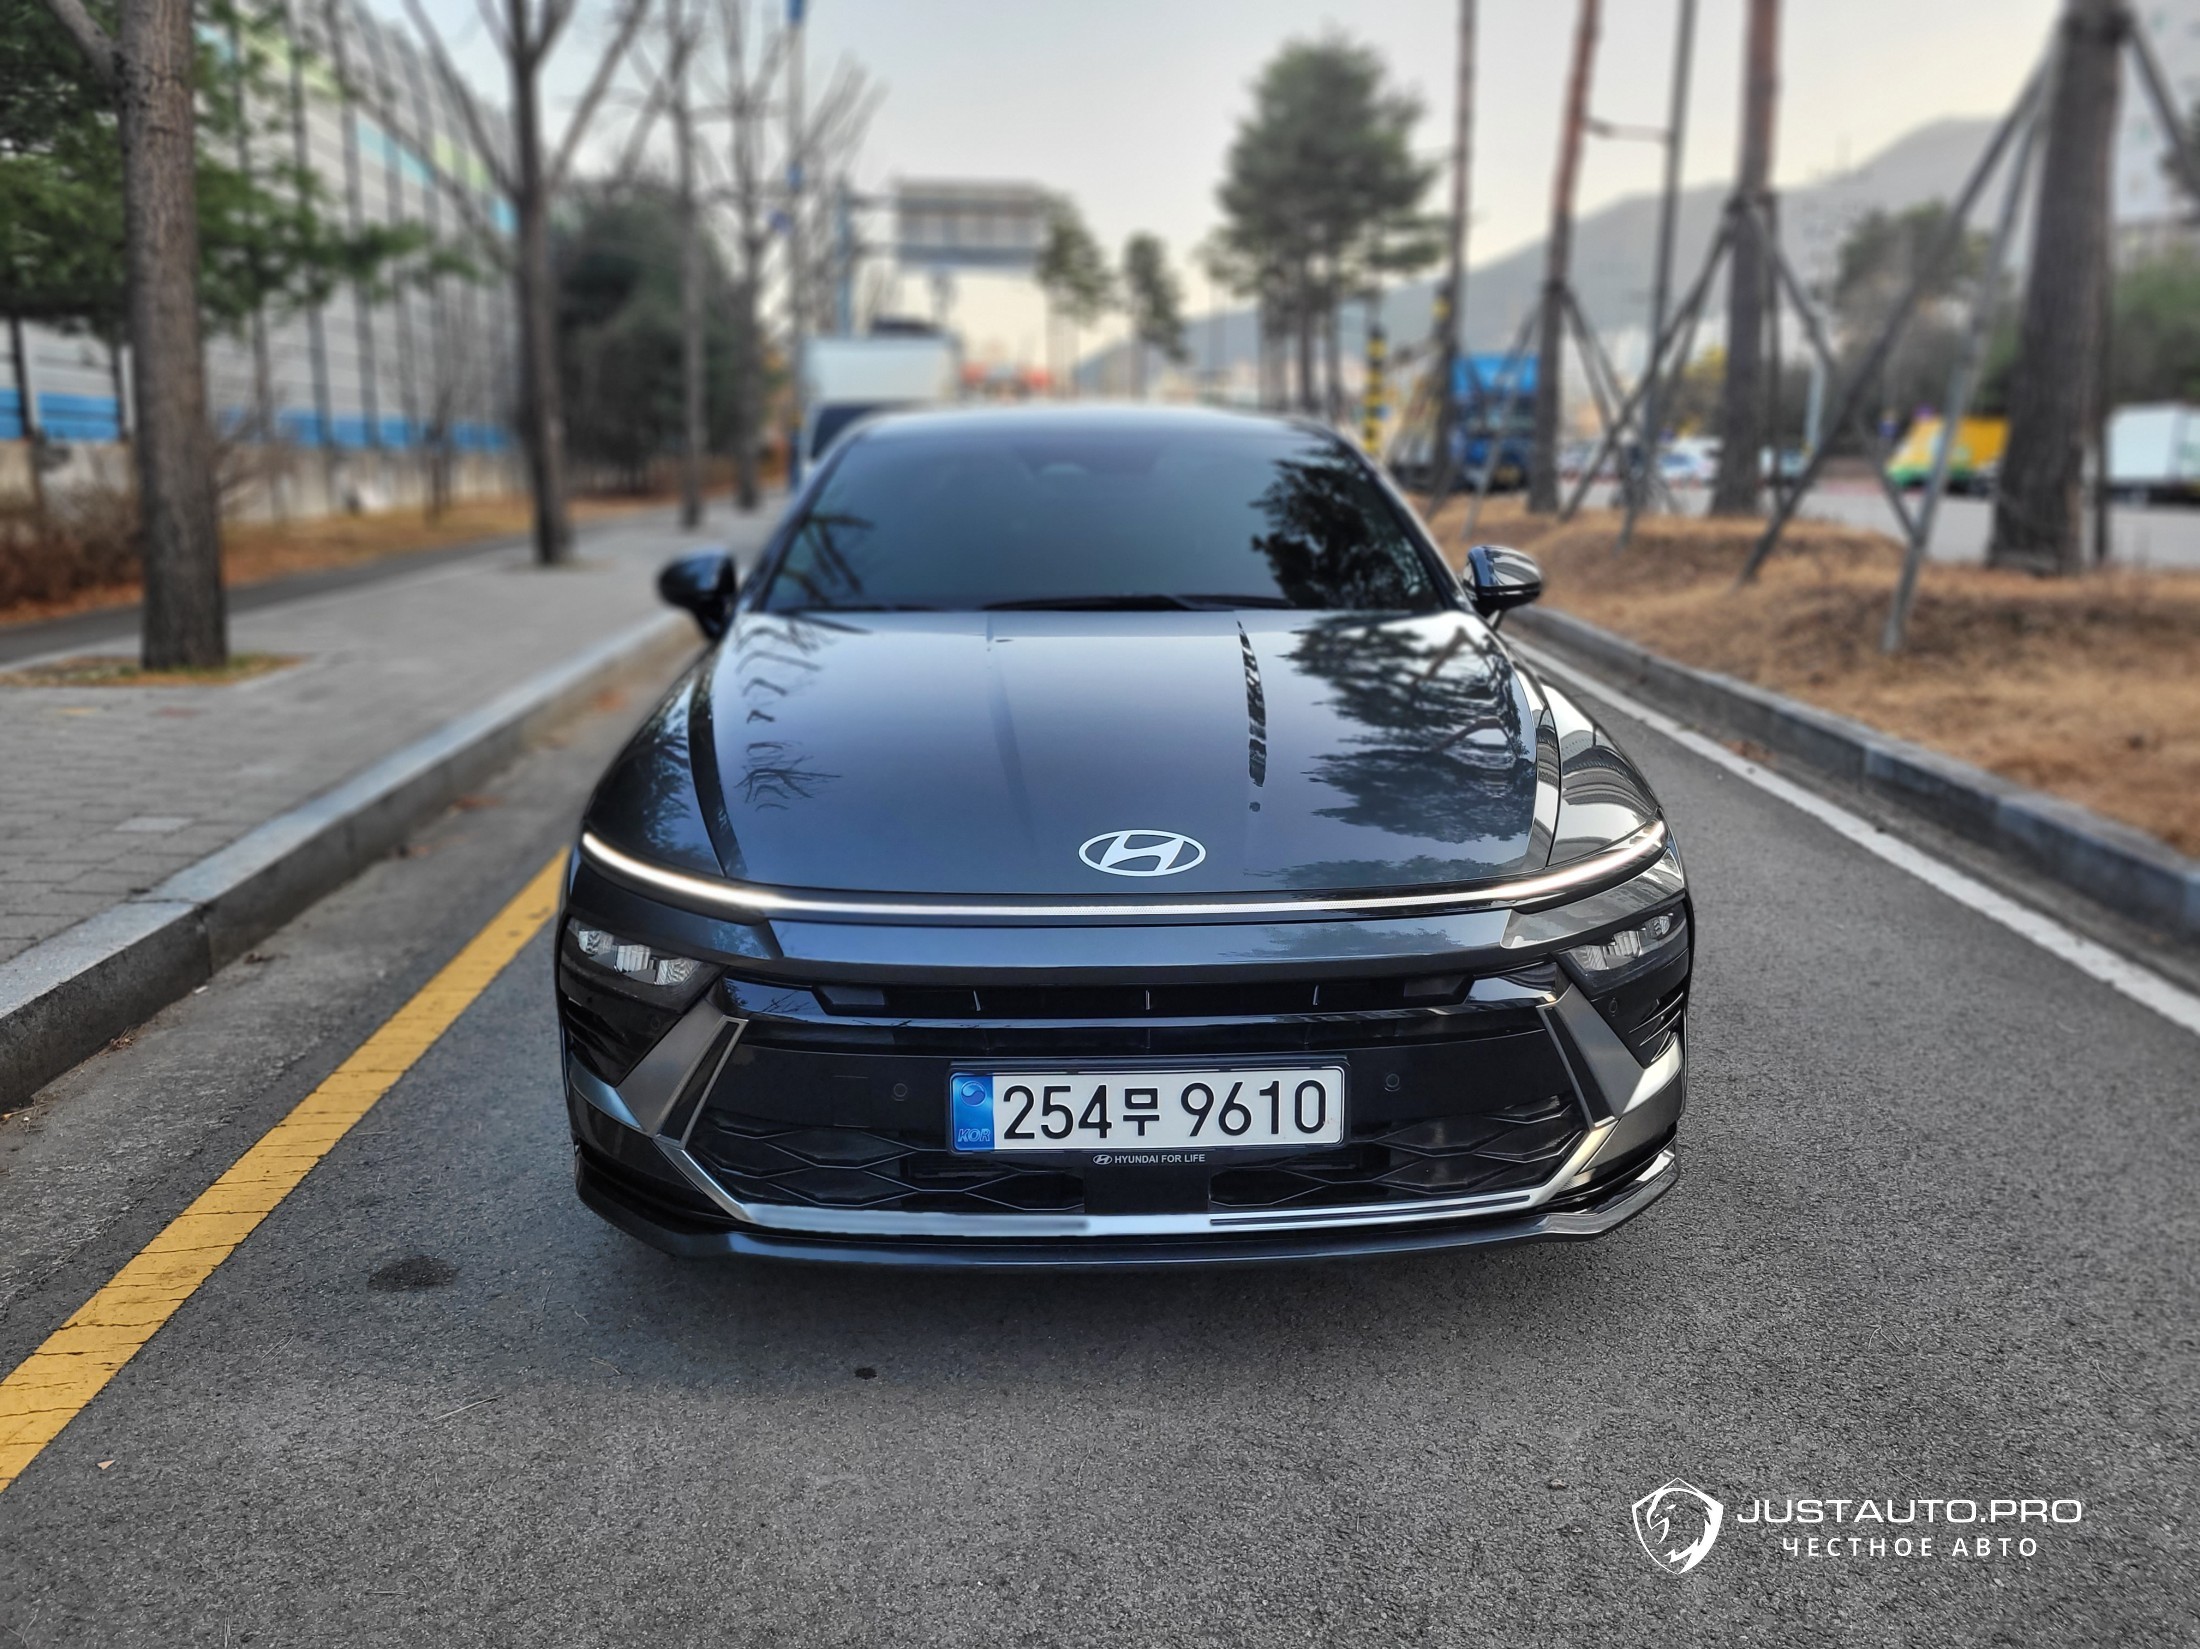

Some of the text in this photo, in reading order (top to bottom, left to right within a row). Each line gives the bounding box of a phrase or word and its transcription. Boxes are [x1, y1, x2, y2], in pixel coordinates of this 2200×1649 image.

[1003, 1079, 1327, 1140] 254무 9610
[957, 1127, 991, 1143] KOR
[1114, 1154, 1206, 1164] HYUNDAI FOR LIFE
